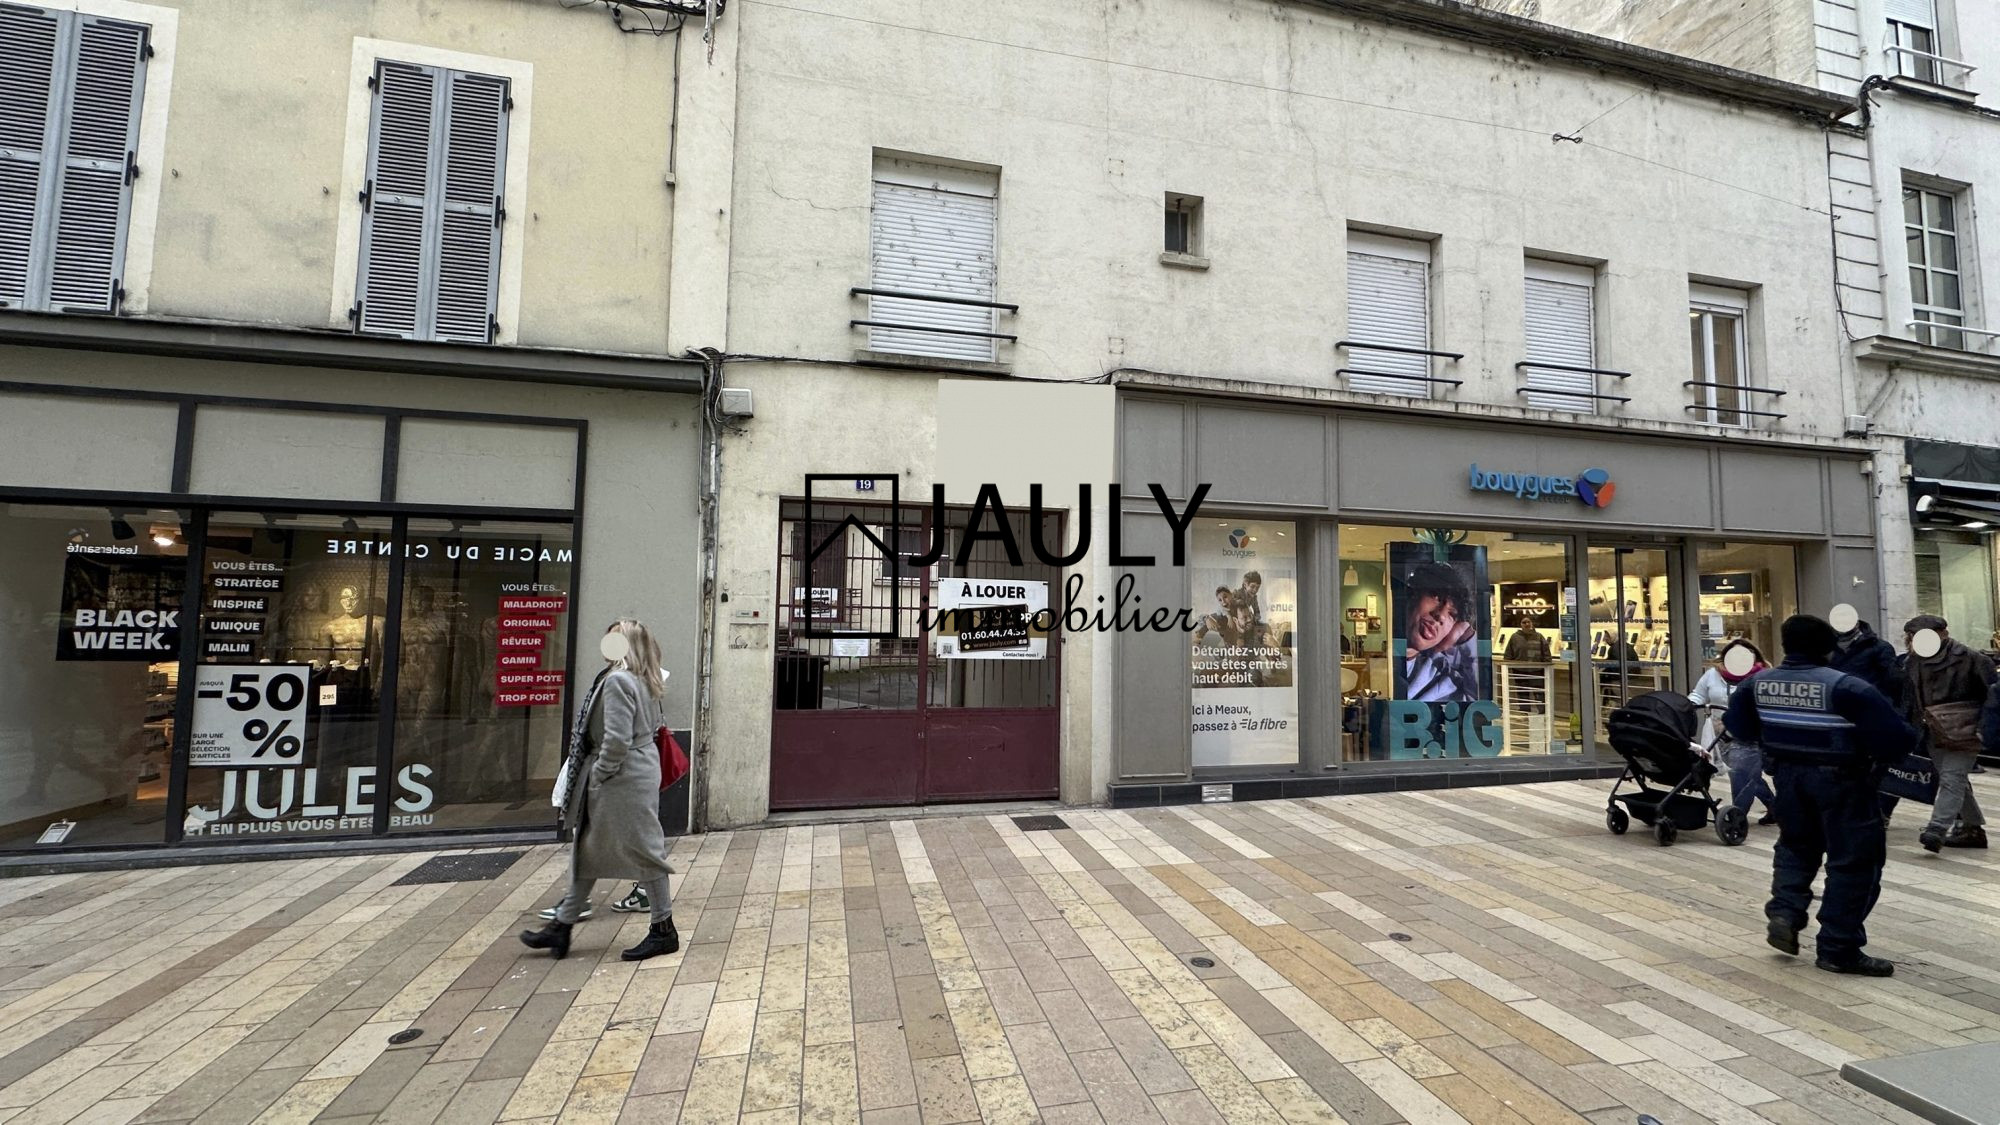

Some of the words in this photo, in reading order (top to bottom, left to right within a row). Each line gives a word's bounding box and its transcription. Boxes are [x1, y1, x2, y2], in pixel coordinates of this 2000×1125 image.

[860, 480, 871, 489] 19
[1470, 463, 1576, 499] bouygues
[1222, 547, 1256, 558] bouygues
[212, 561, 245, 570] VOUS
[214, 576, 279, 588] STRATÈGE
[501, 583, 530, 592] VOUS
[961, 582, 972, 597] À
[976, 585, 1026, 599] LOUER
[213, 599, 264, 609] INSPIRÉ
[503, 601, 563, 609] MALADROIT
[75, 608, 179, 628] BLACK
[503, 619, 551, 627] ORIGINAL
[210, 621, 260, 633] UNIQUE
[73, 631, 171, 650] WEEK.
[501, 636, 541, 646] RÊVEUR
[208, 643, 250, 652] MALIN
[501, 656, 536, 664] GAMIN
[1192, 660, 1220, 670] vous
[1221, 659, 1247, 670] êtes
[1248, 660, 1263, 670] en
[1265, 659, 1288, 670] très
[500, 675, 533, 683] SUPER
[536, 674, 562, 682] POTE
[1192, 672, 1220, 684] haut
[1221, 671, 1253, 684] débit
[1757, 681, 1821, 698] POLICE
[499, 694, 527, 702] TROP
[529, 693, 556, 701] FORT
[1757, 694, 1821, 708] MUNICIPALE
[1192, 704, 1205, 715] Ici
[1206, 705, 1213, 715] à
[1215, 704, 1252, 716] Meaux,
[1192, 722, 1229, 734] passez
[1230, 720, 1237, 730] à
[1259, 717, 1288, 730] fibre
[187, 763, 433, 821] JULES
[185, 825, 206, 836] ET
[210, 823, 233, 835] EN
[238, 821, 282, 834] PLUS
[286, 818, 334, 832] VOUS
[339, 815, 373, 829] ÊTES
[390, 814, 433, 827] BEAU
